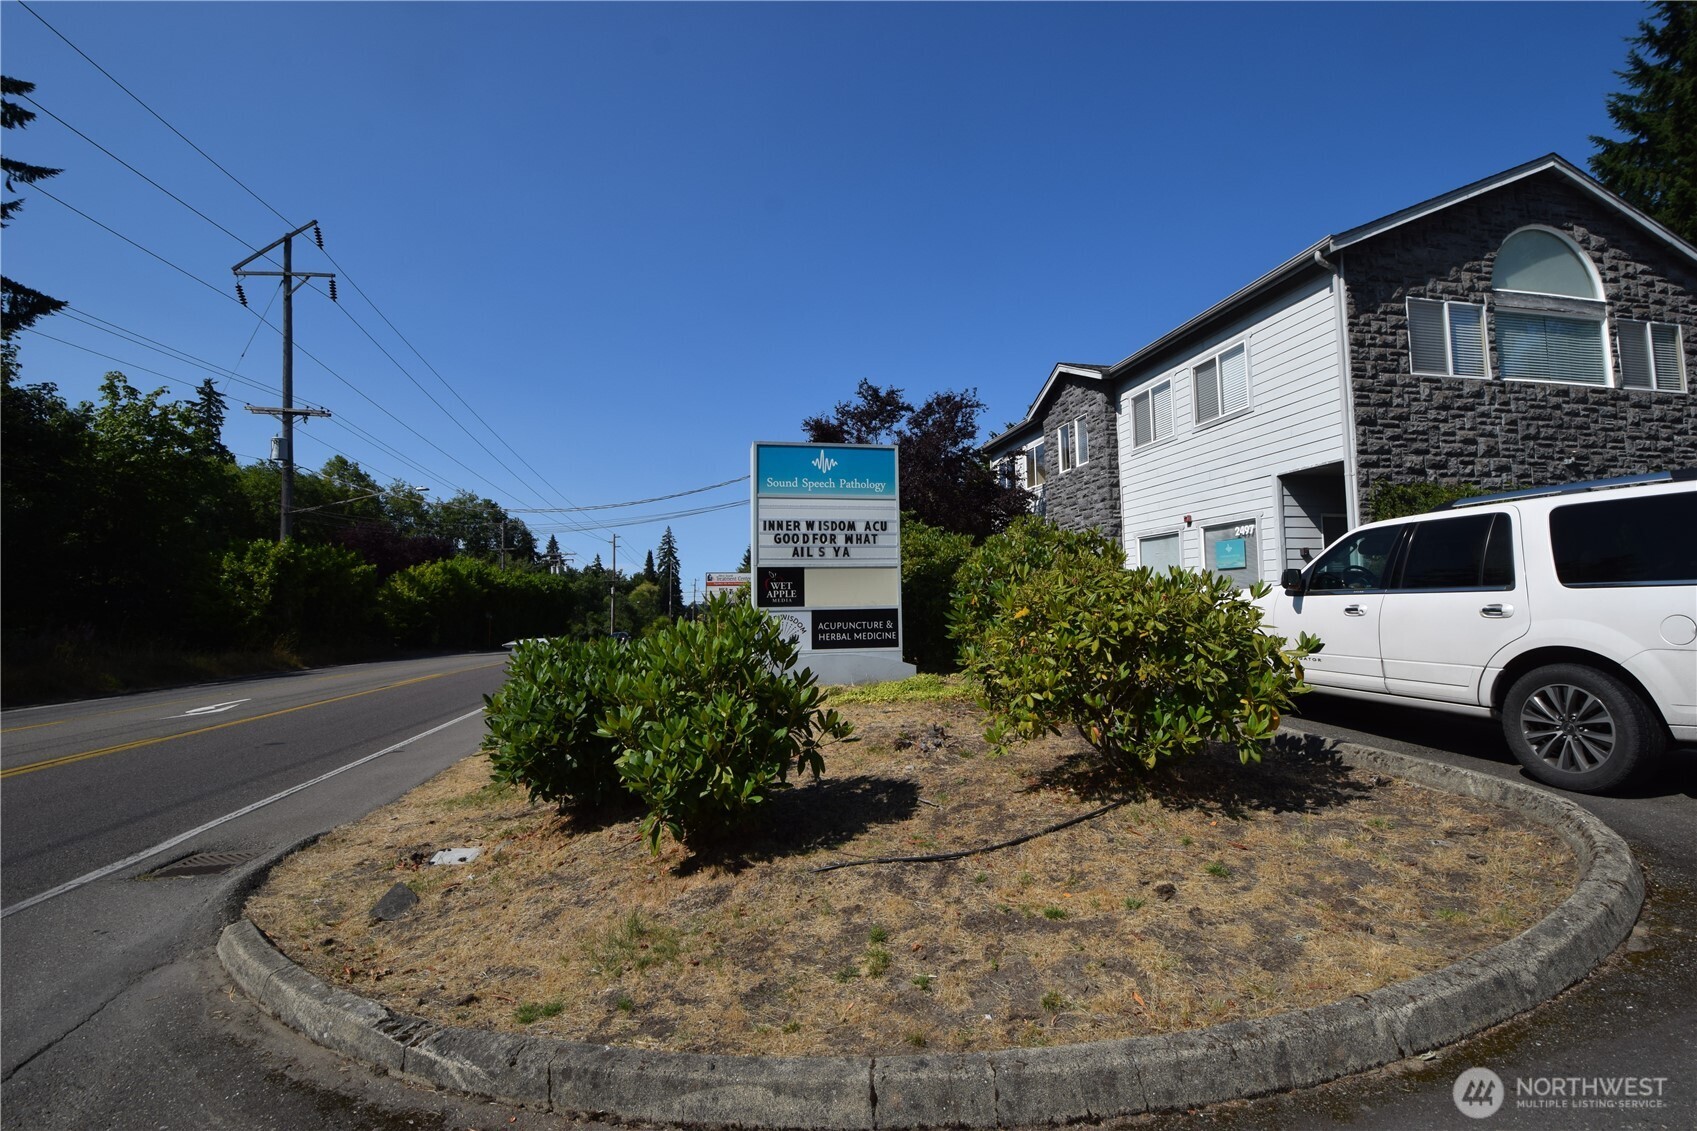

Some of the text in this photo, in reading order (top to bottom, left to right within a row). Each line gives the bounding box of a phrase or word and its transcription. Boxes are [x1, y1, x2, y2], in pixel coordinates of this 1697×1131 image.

[767, 477, 886, 492] Sound Speech Pathology
[763, 520, 888, 531] INNER WISDOM ACU
[1234, 524, 1255, 536] 2497
[845, 533, 878, 544] WHAT
[833, 546, 850, 557] YA
[770, 581, 793, 590] WET
[766, 590, 797, 598] APPLE
[818, 620, 894, 630] ACUPUNCTURE &
[818, 631, 896, 641] HERBAL MEDICINE
